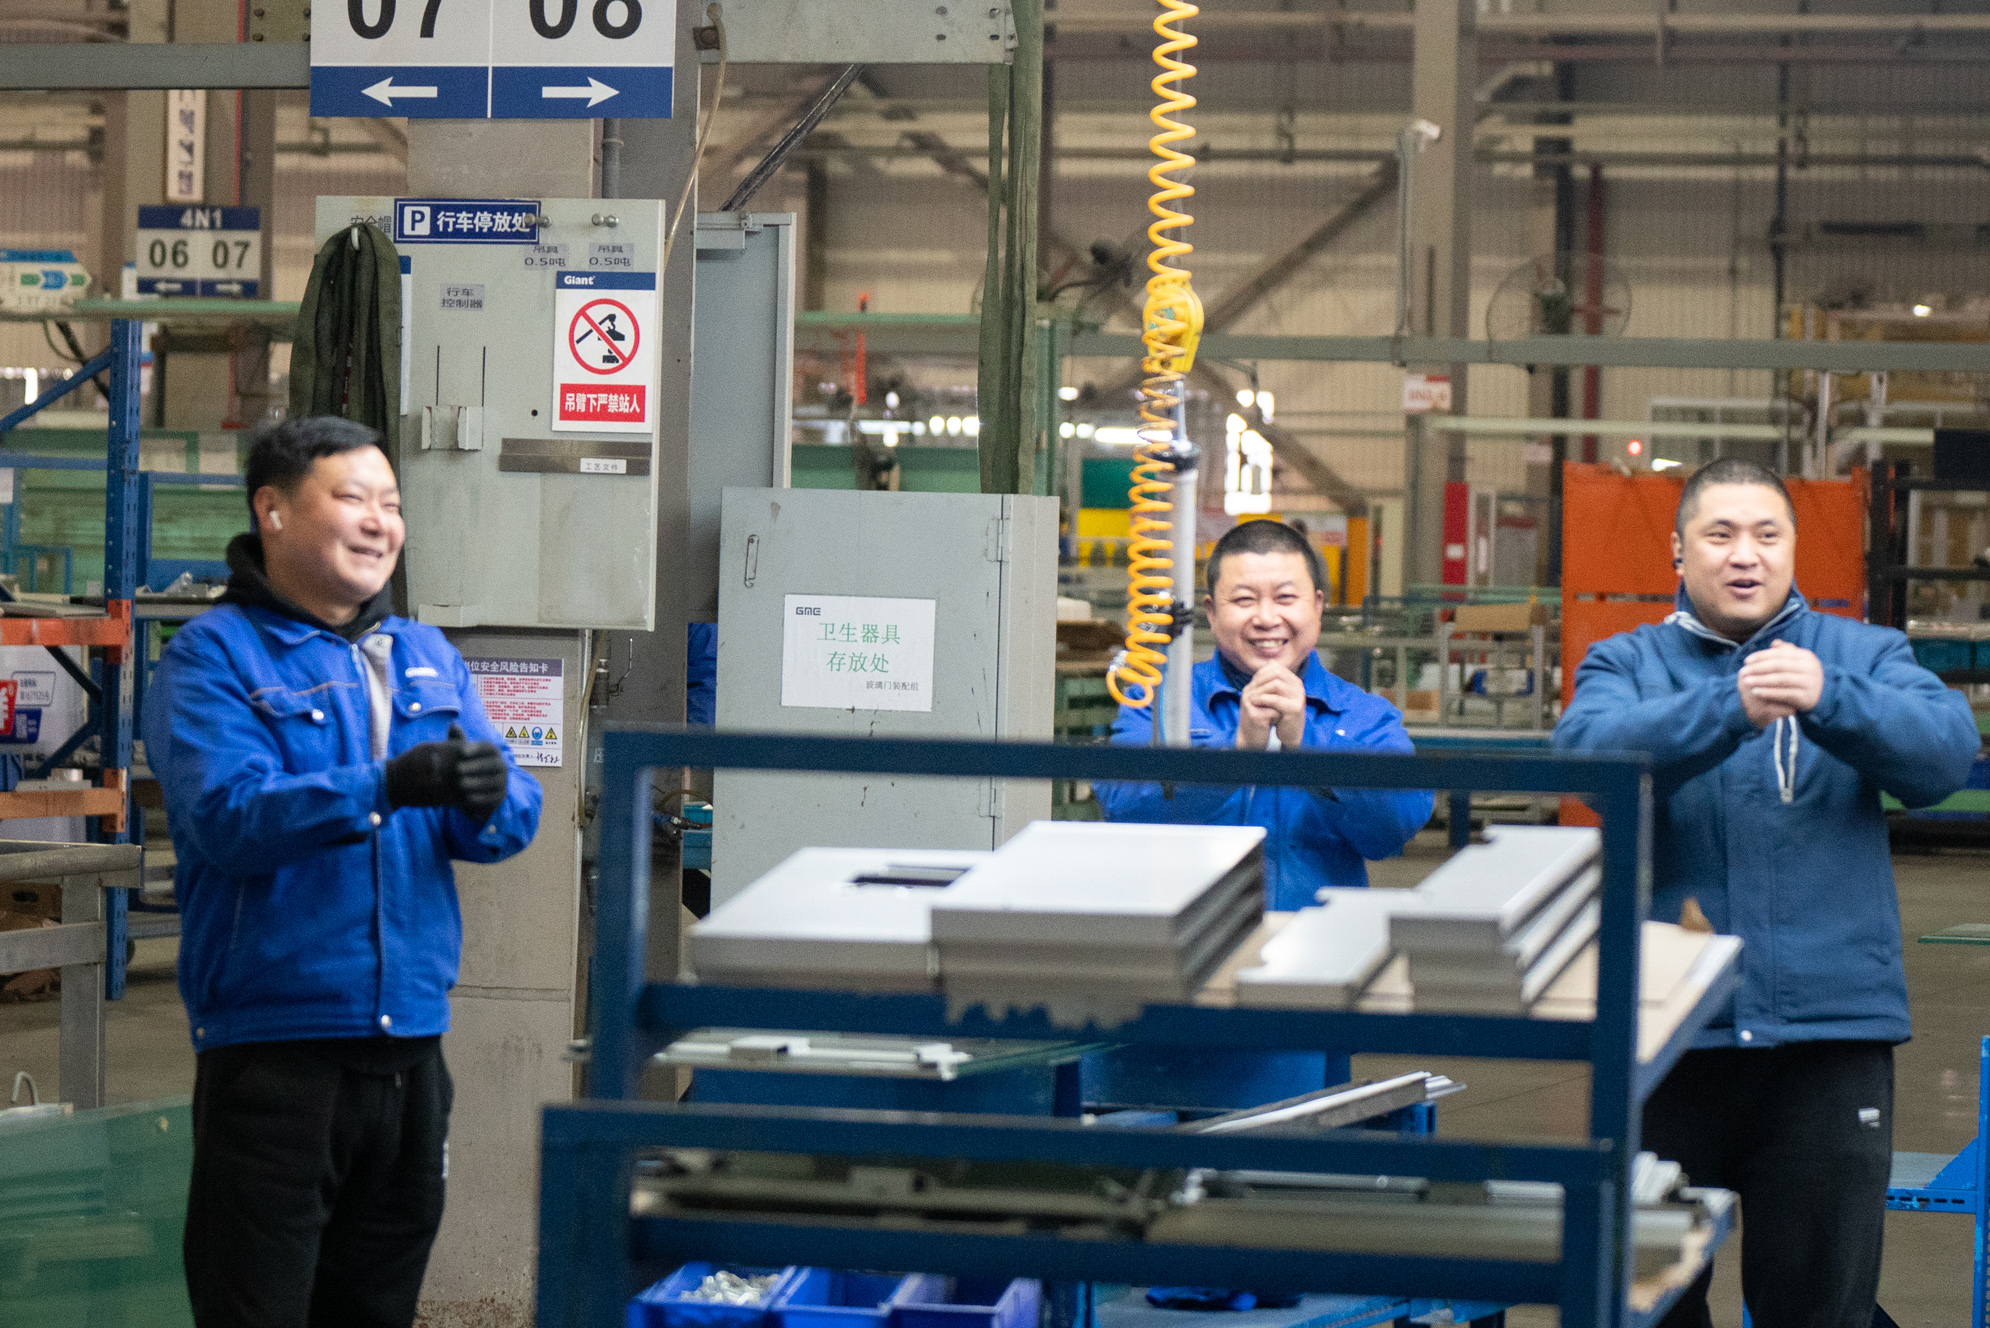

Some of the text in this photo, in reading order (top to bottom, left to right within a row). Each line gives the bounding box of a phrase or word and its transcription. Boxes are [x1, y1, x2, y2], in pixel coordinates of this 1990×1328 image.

[180, 207, 222, 228] 4N1
[436, 210, 532, 233] 行车停放处
[149, 239, 251, 269] 06 07
[563, 275, 594, 285] Giant
[446, 287, 475, 297] 行车
[441, 298, 483, 309] 控制器
[565, 393, 640, 413] 吊臂下严禁站人
[585, 462, 619, 472] 工艺文件
[795, 606, 822, 616] GME
[816, 622, 901, 645] 卫生器具
[467, 660, 549, 674] 位安全风险告知卡
[826, 651, 890, 673] 存放处
